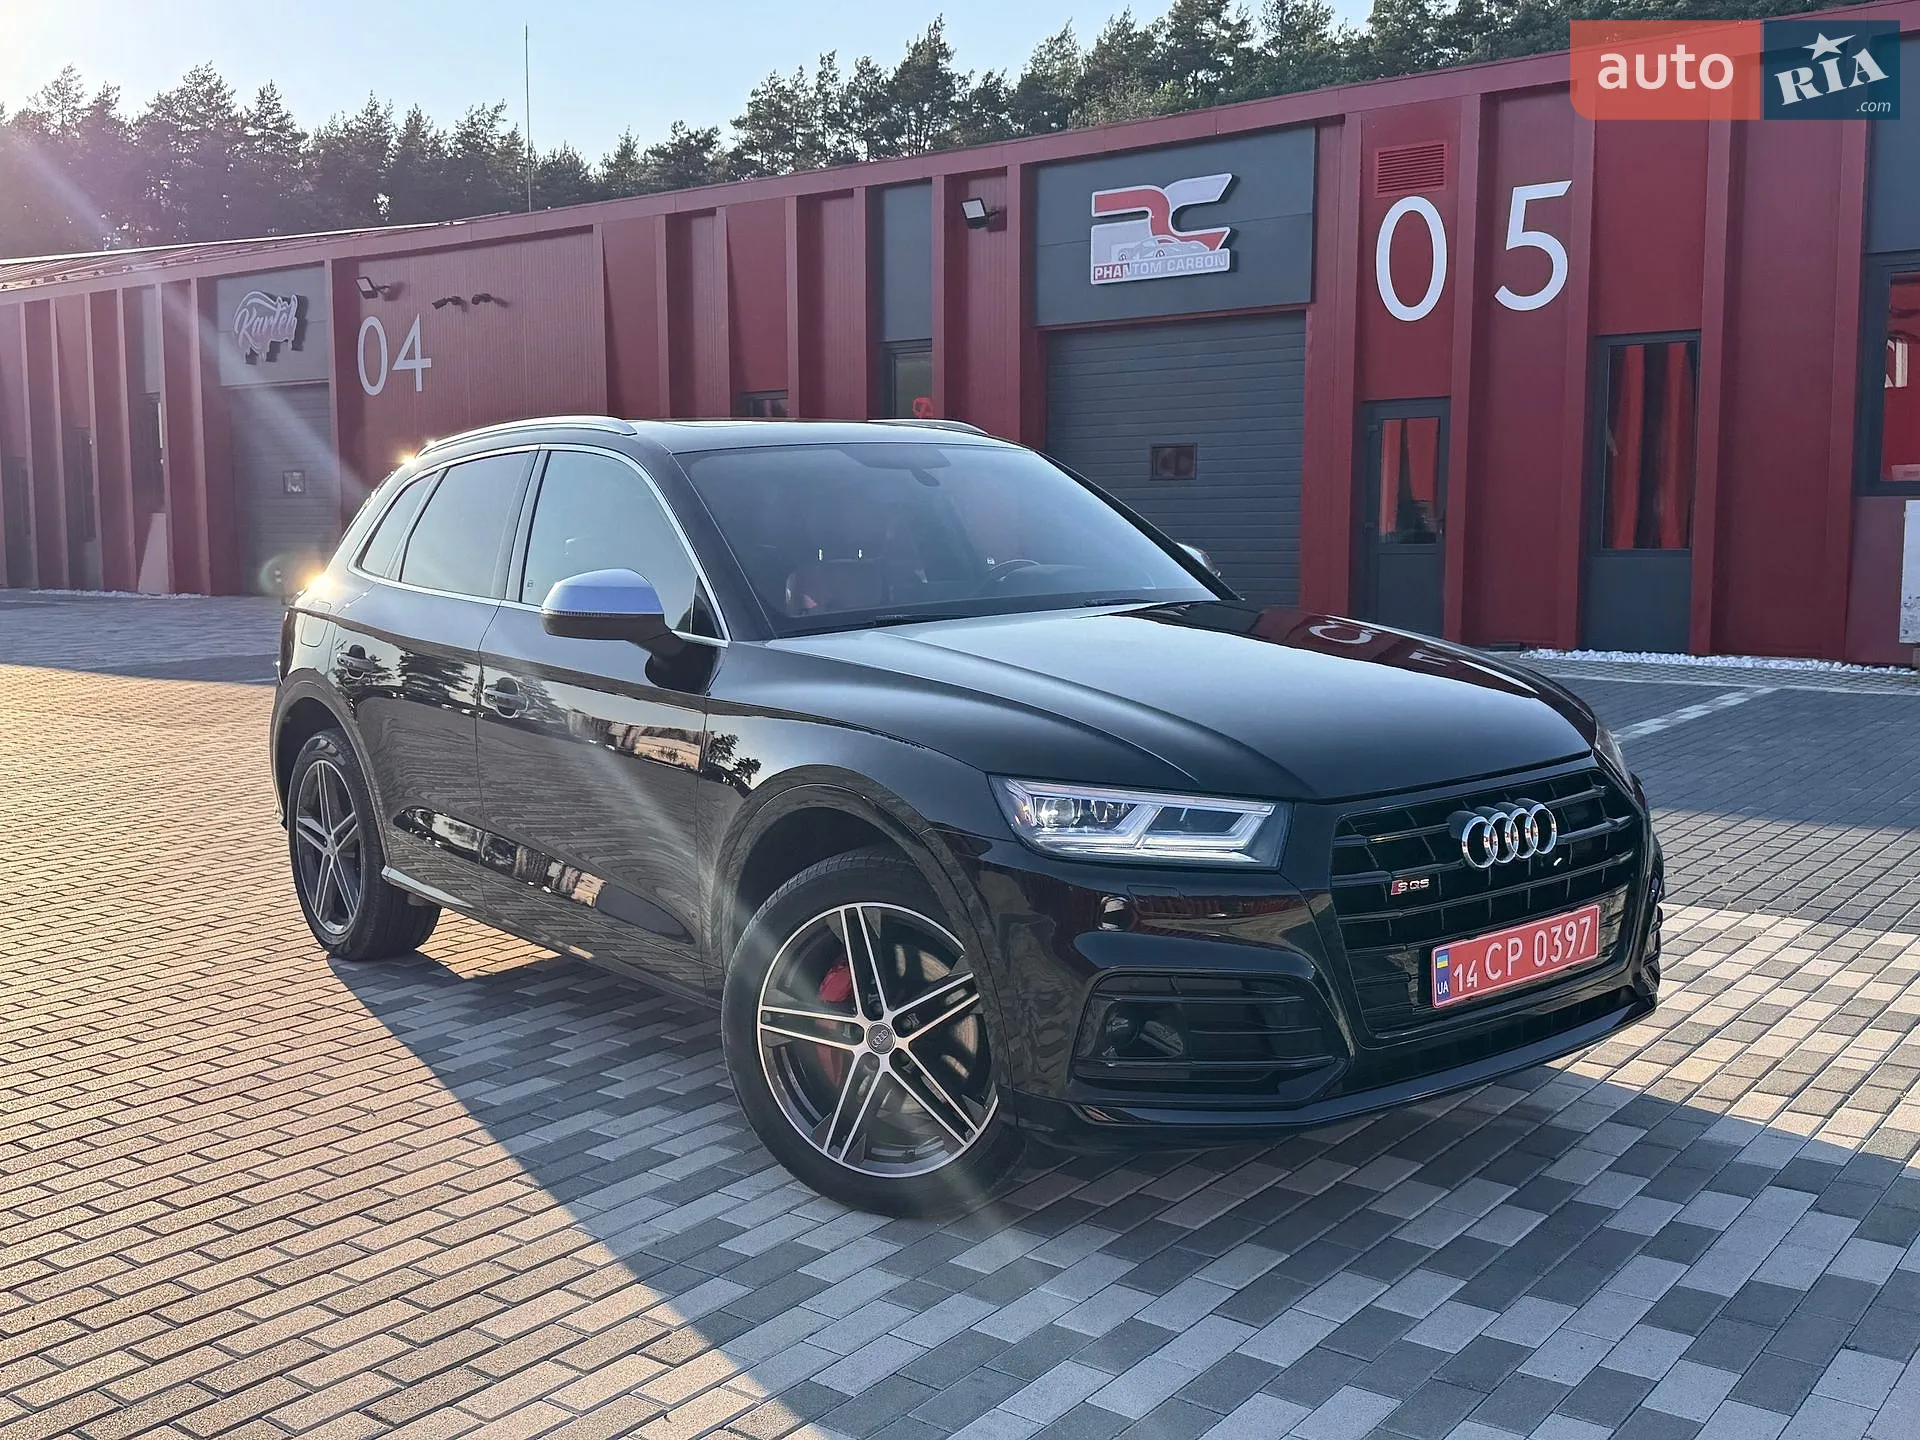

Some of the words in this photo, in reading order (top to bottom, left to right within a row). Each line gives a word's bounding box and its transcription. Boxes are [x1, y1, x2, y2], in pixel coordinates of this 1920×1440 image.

[1094, 261, 1162, 281] PHANTOM
[1167, 254, 1226, 272] CARBON
[357, 312, 432, 396] 04
[1397, 878, 1430, 892] SQ5
[1453, 959, 1478, 993] 14
[1485, 937, 1523, 981] CP
[1533, 915, 1591, 968] 0397
[1437, 981, 1449, 995] UA
